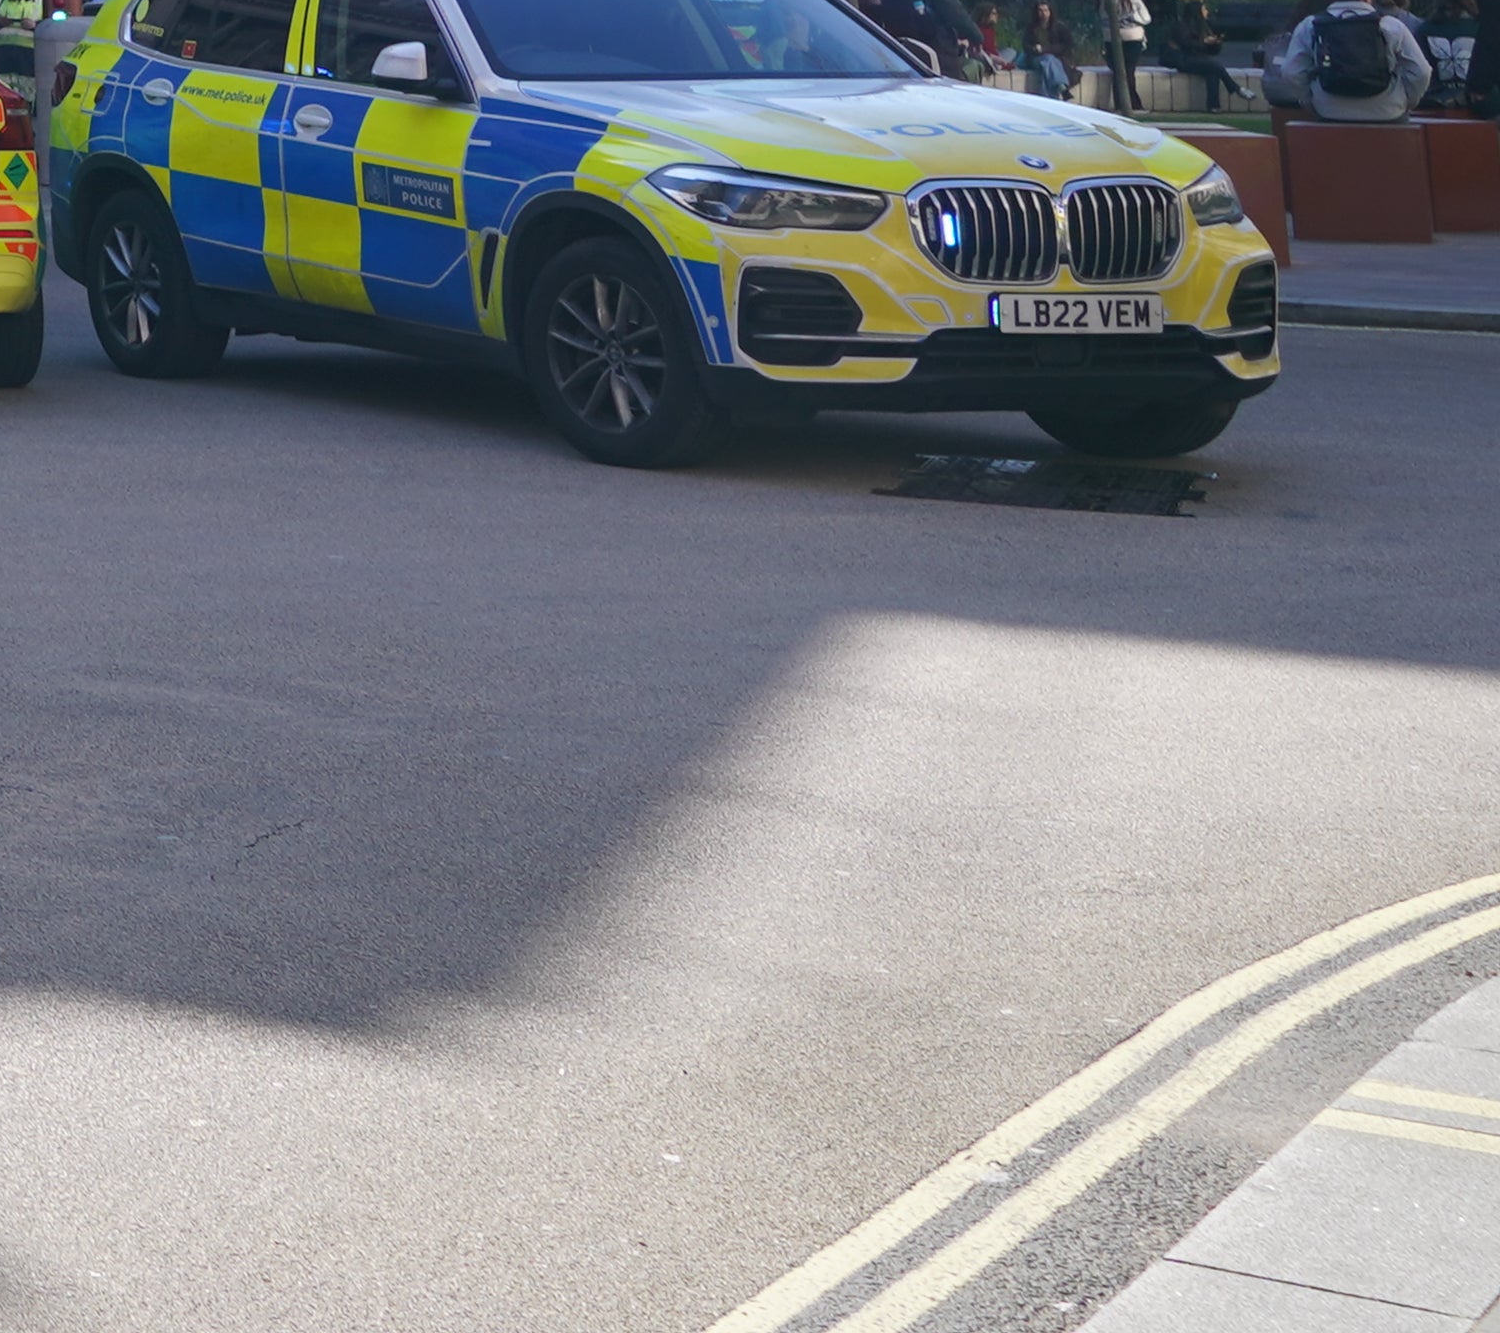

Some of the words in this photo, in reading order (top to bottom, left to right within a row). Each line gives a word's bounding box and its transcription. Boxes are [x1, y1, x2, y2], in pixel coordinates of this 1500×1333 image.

[179, 84, 268, 106] www.met.police.uk
[864, 122, 1098, 139] POLICE
[392, 174, 450, 194] METROPOLITAN
[401, 191, 444, 210] POLICE
[1013, 300, 1090, 328] LB22
[1098, 300, 1151, 328] VEM
